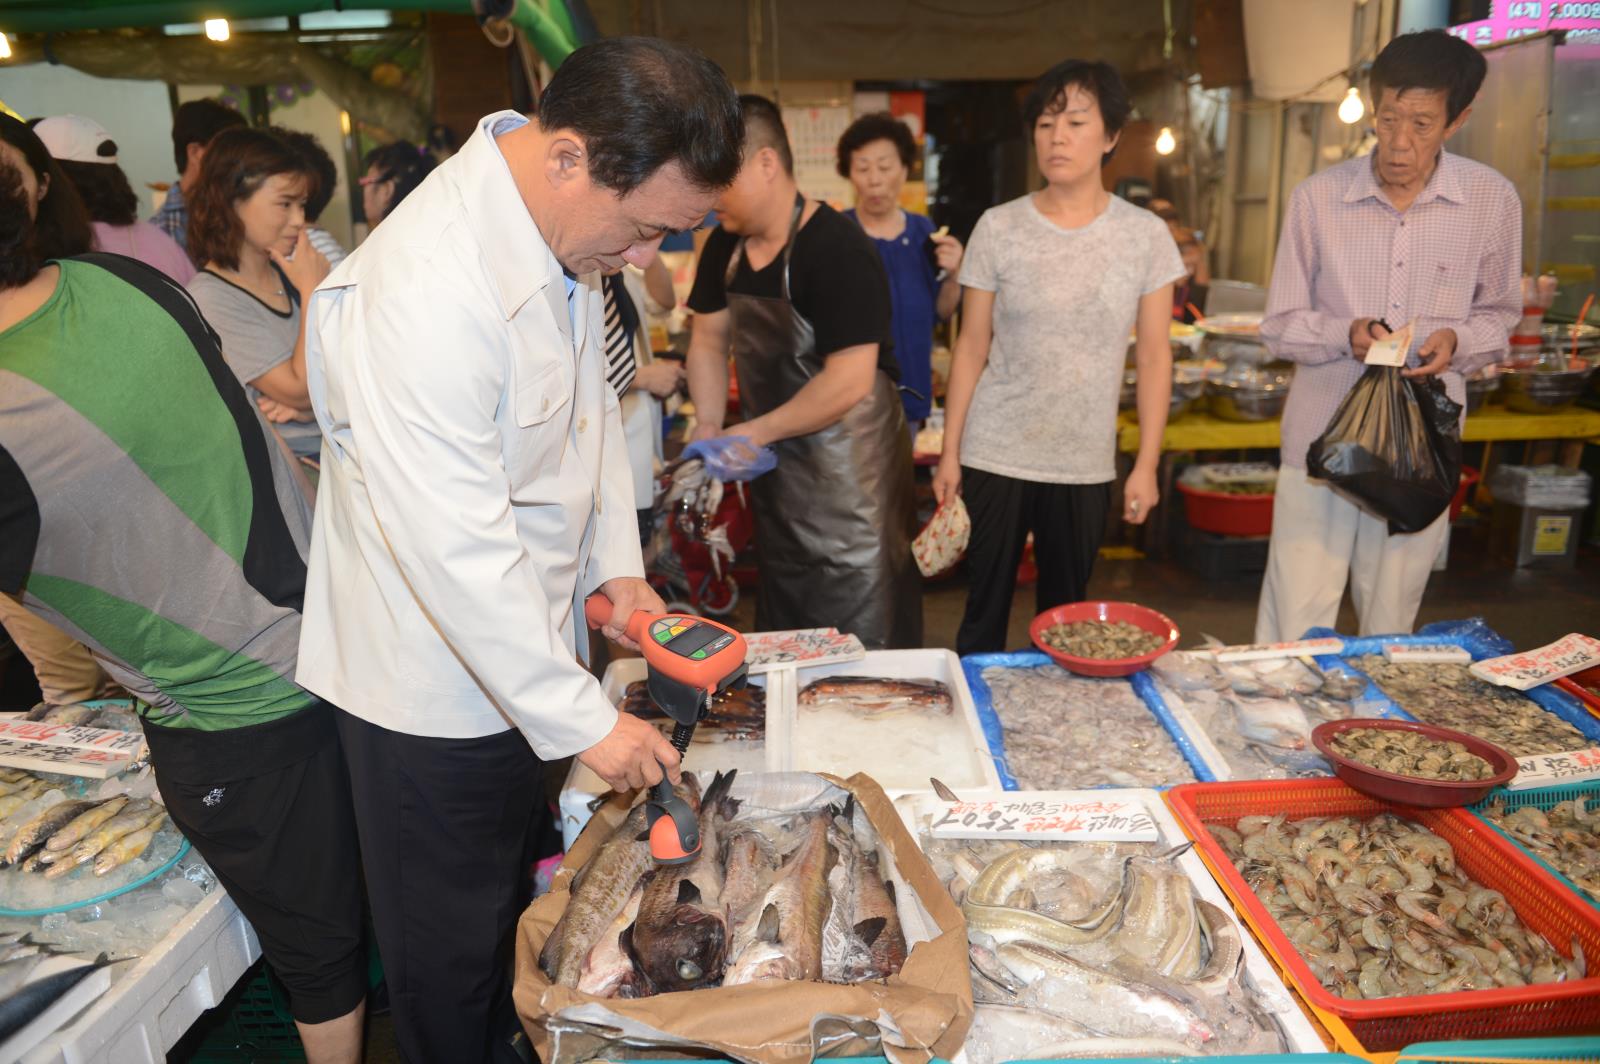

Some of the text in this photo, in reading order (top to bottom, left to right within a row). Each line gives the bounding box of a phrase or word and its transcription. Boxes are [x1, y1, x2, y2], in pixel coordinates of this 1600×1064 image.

[932, 808, 1153, 833] 국내산 자연산 장어
